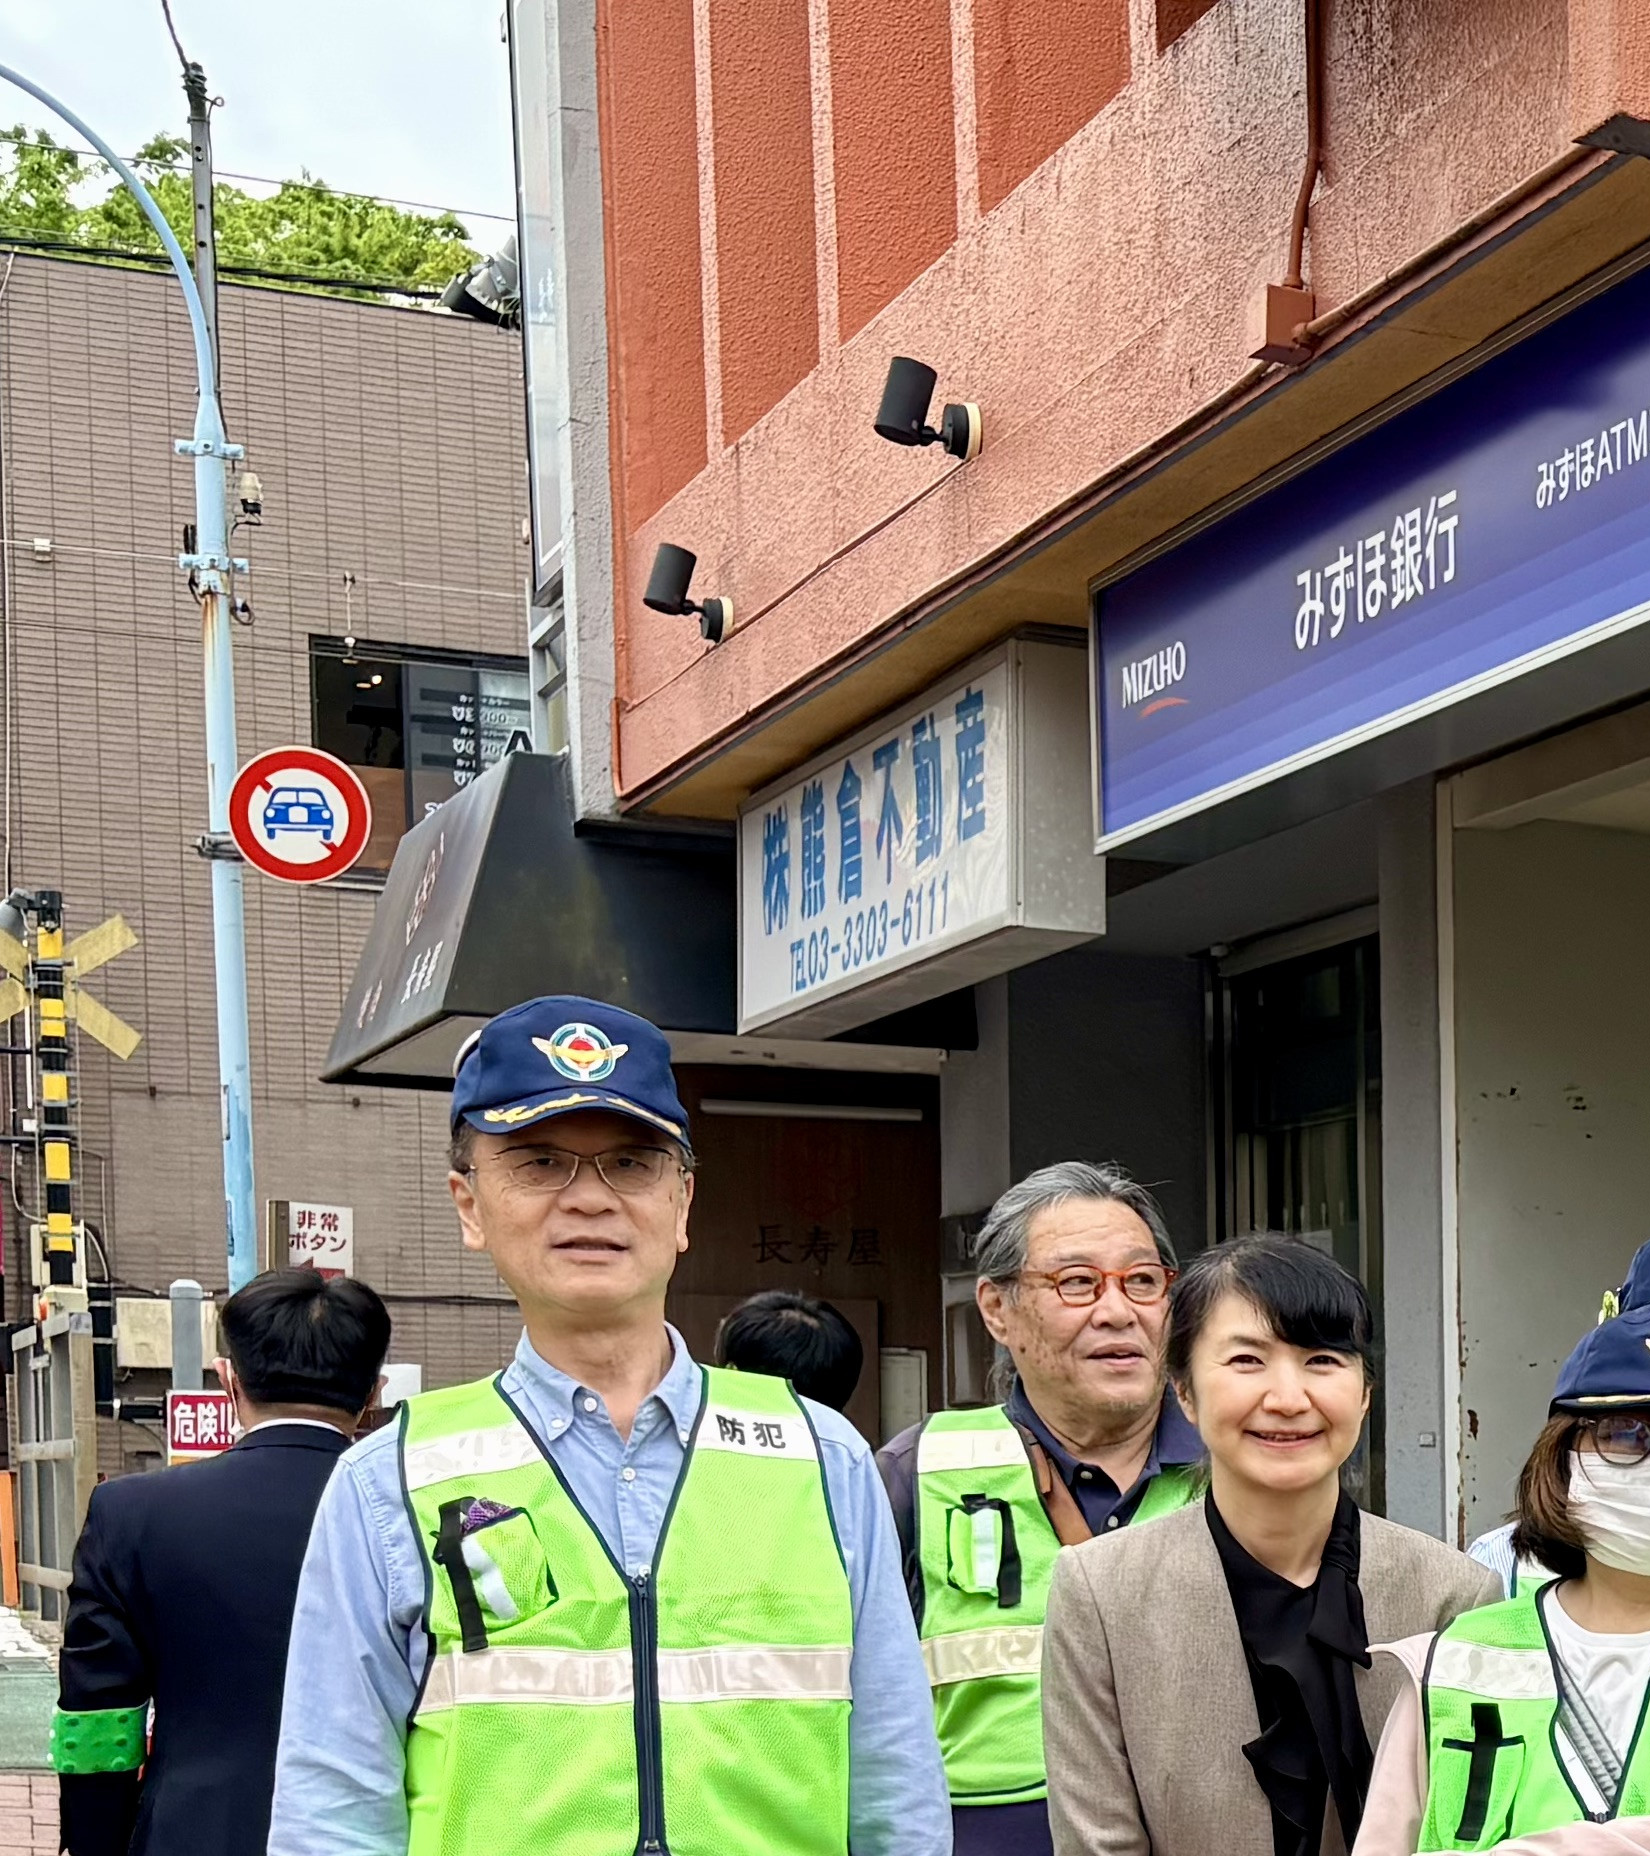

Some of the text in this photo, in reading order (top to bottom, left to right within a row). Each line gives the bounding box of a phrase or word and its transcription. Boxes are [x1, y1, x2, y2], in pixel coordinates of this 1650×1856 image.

[1295, 489, 1458, 649] みずほ銀行
[1121, 640, 1186, 708] MIZUHO
[297, 1210, 340, 1232] 非常
[289, 1232, 347, 1252] ボタン
[752, 1223, 886, 1266] 長寿屋
[716, 1414, 786, 1449] 防犯
